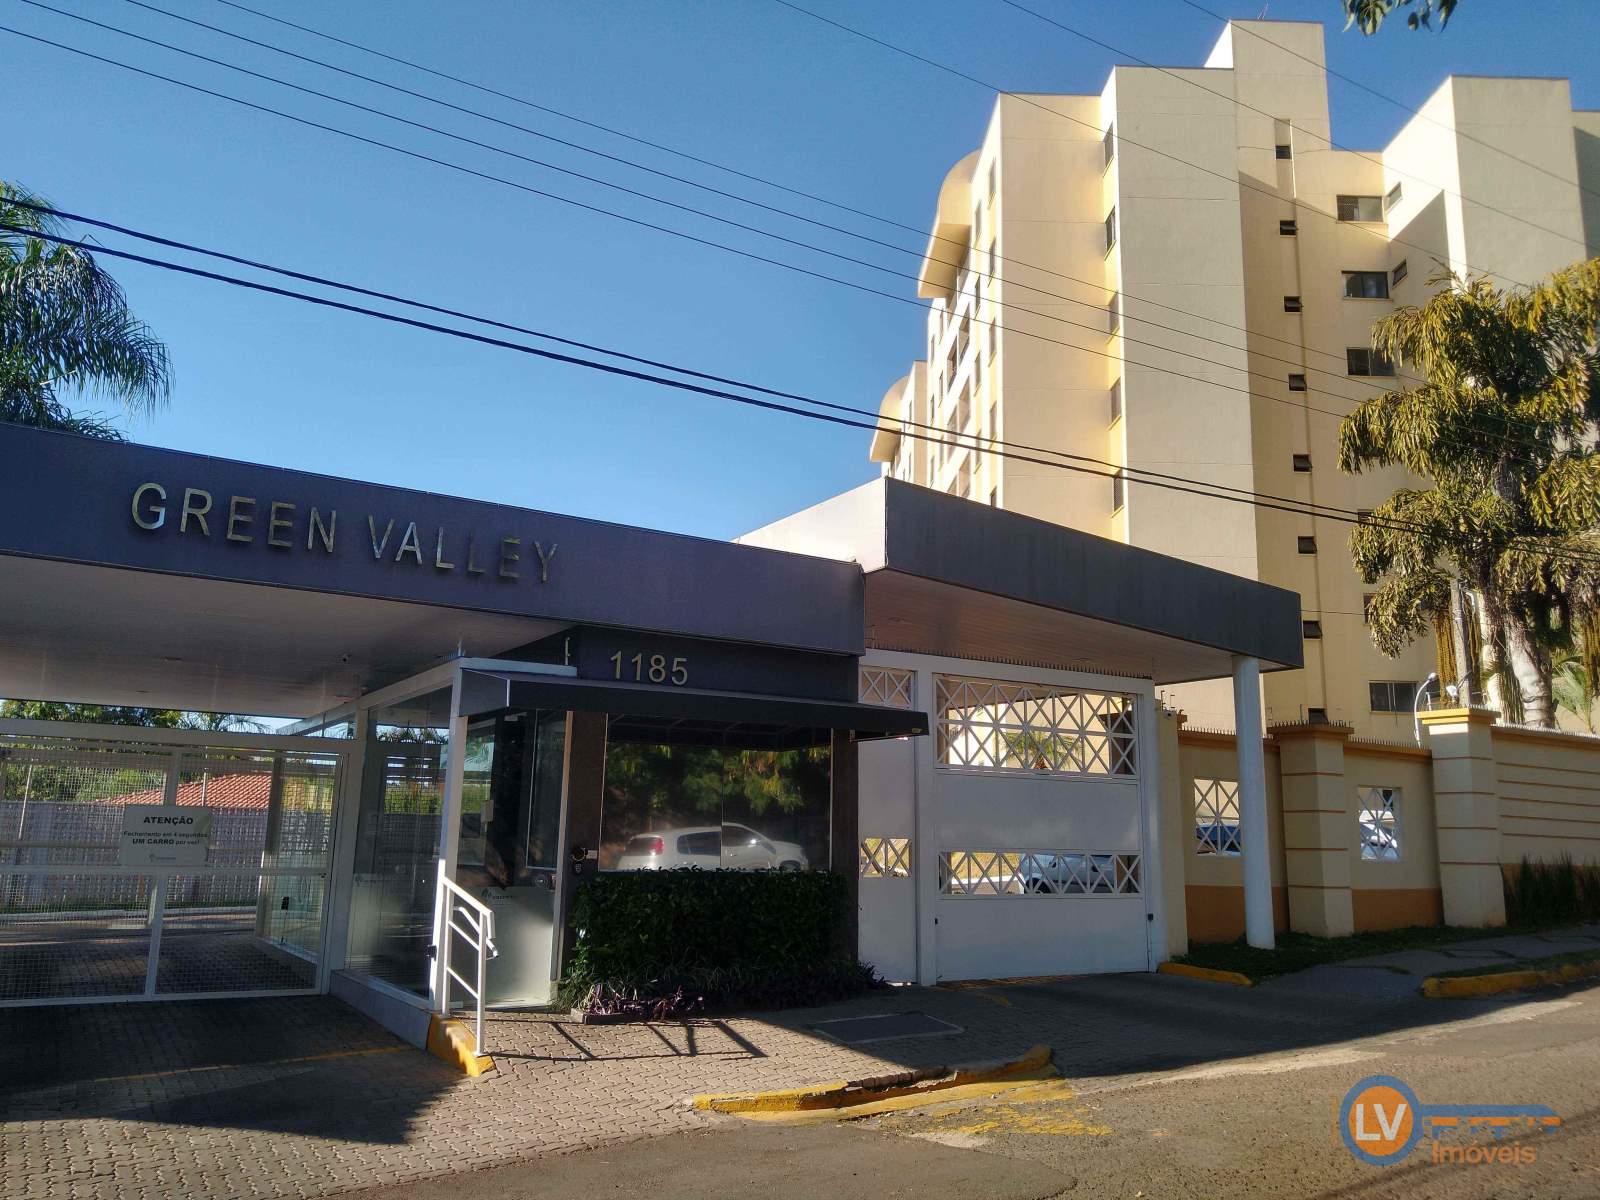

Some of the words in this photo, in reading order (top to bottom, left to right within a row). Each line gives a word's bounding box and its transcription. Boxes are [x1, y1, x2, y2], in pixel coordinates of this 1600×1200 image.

[132, 482, 337, 553] GREEN
[368, 514, 559, 582] VALLEY
[610, 650, 688, 685] 1185
[143, 816, 194, 826] ATENÇÃO
